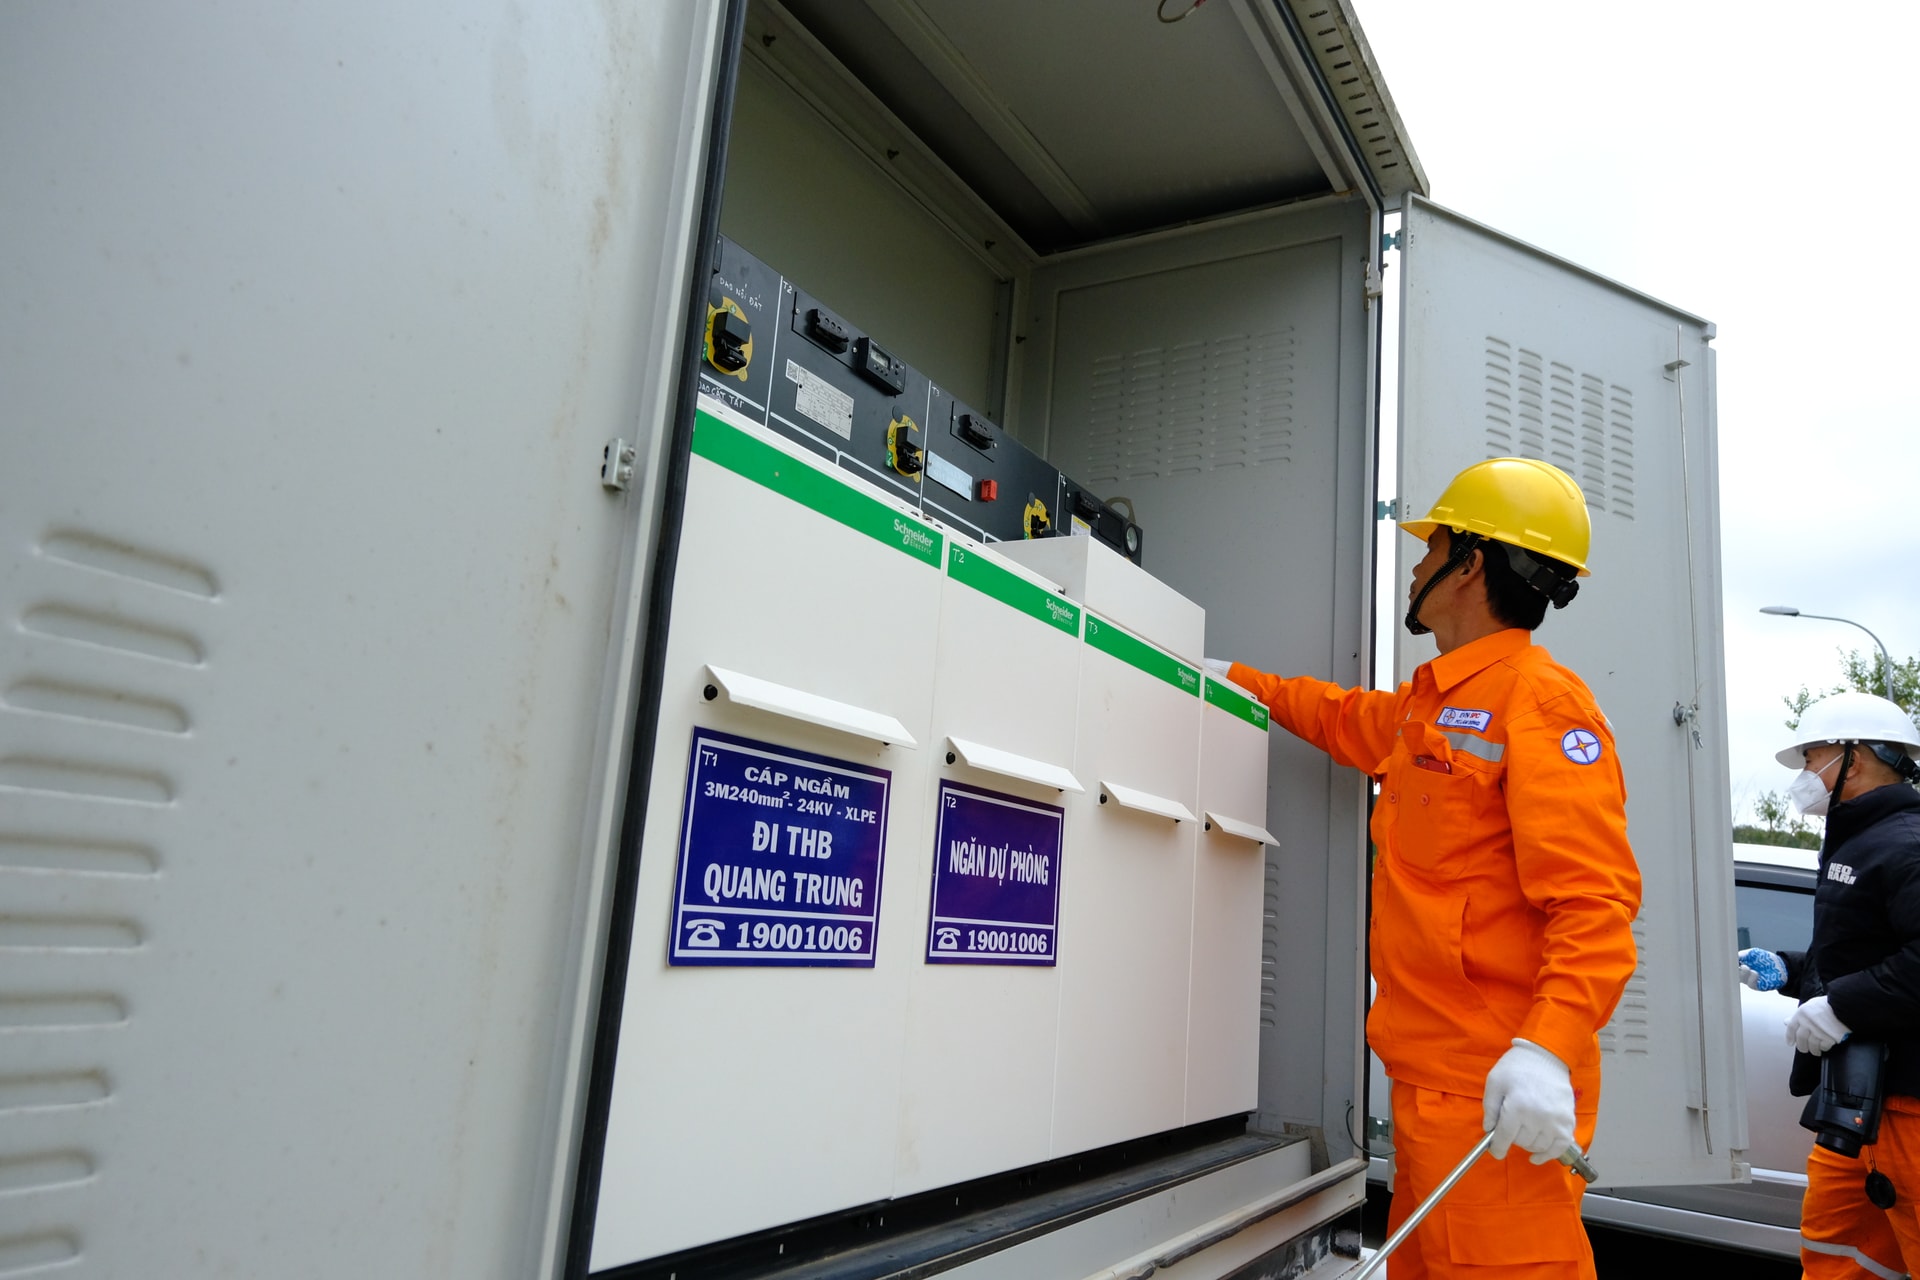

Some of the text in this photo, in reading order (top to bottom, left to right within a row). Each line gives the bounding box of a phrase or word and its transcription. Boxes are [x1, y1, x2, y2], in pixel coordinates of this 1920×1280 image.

[783, 280, 792, 294] T2
[894, 518, 934, 548] Schneider
[952, 548, 964, 564] T2
[1046, 598, 1074, 620] Schneider
[1088, 621, 1098, 634] T3
[702, 750, 718, 766] T1
[744, 766, 850, 799] CÁP NGẦM
[797, 798, 833, 817] 24KV
[845, 806, 876, 824] XLPE
[946, 796, 956, 808] T2
[752, 820, 833, 860] ĐI THB
[950, 836, 1049, 886] NGĂN DỰ PHÒNG
[704, 863, 863, 908] QUANG TRUNG
[736, 922, 862, 950] 19001006
[968, 930, 1048, 952] 19001006
